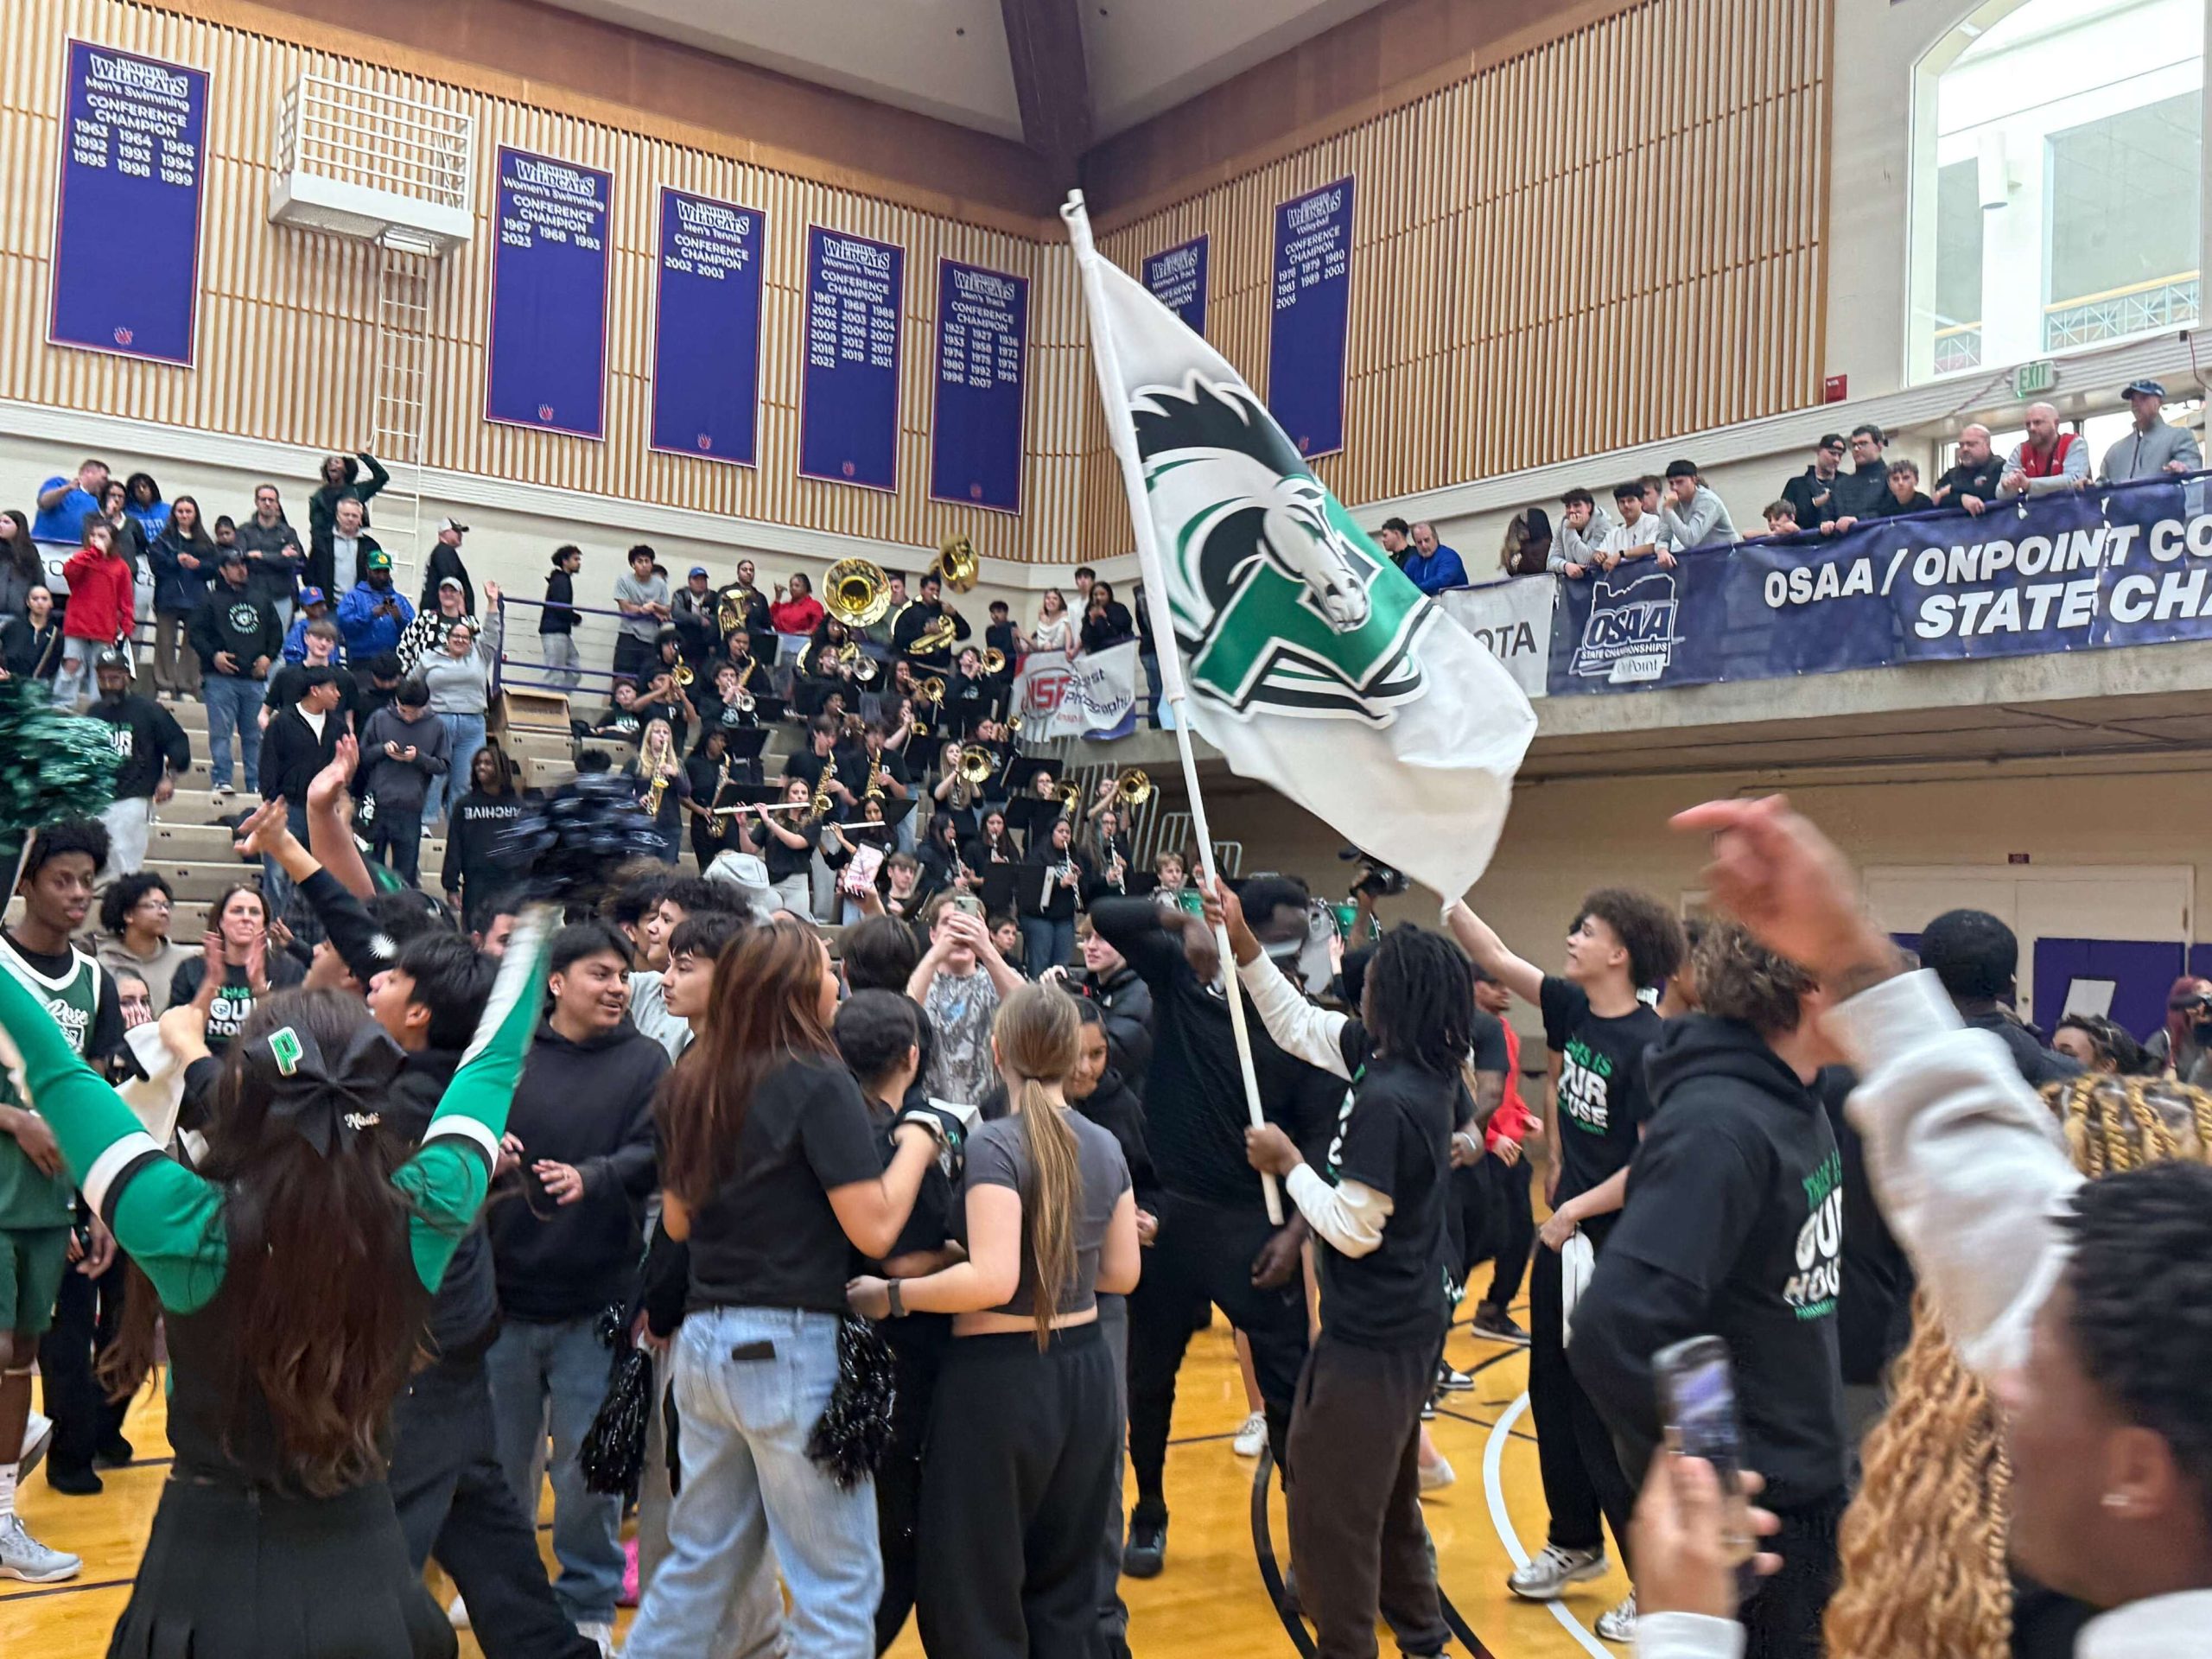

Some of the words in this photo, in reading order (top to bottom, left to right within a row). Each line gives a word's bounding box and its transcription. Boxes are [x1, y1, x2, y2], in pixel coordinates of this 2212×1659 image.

[90, 53, 188, 98] WILDCATS
[85, 75, 122, 94] Men's
[124, 86, 190, 112] Swimming
[86, 92, 188, 128] CONFERENCE
[94, 109, 177, 138] CHAMPION
[74, 118, 109, 137] 1963
[118, 128, 153, 148] 1964
[162, 138, 194, 157] 1965
[74, 133, 107, 153] 1992
[118, 143, 151, 162] 1993
[161, 153, 194, 172] 1994
[73, 148, 107, 168] 1995
[116, 158, 150, 177] 1998
[159, 168, 193, 187] 1999
[502, 175, 550, 197] Women's
[552, 188, 605, 213] Swimming
[512, 194, 594, 224] CONFERENCE
[519, 207, 586, 234] CHAMPION
[677, 198, 750, 236] WILDCATS
[501, 231, 531, 248] 2023
[503, 217, 531, 234] 1967
[539, 226, 567, 243] 1968
[574, 233, 601, 251] 1993
[674, 233, 749, 261] CONFERENCE
[683, 221, 710, 237] Men's
[712, 227, 741, 244] Tennis
[1285, 225, 1340, 256] CONFERENCE
[681, 247, 742, 271] CHAMPION
[1289, 239, 1334, 265] CHAMPION
[664, 255, 692, 273] 2002
[696, 263, 725, 280] 2003
[821, 269, 889, 296] CONFERENCE
[827, 282, 883, 304] CHAMPION
[812, 303, 837, 319] 2002
[842, 310, 867, 326] 2003
[871, 317, 895, 332] 2004
[951, 300, 1014, 325] CONFERENCE
[957, 313, 1007, 334] CHAMPION
[811, 315, 836, 331] 2005
[841, 322, 867, 338] 2006
[870, 329, 894, 344] 2007
[811, 328, 836, 344] 2008
[842, 334, 864, 350] 2012
[871, 341, 893, 356] 2017
[810, 353, 835, 369] 2022
[2019, 364, 2047, 390] EXIT
[1764, 557, 1873, 608] OSAA
[1912, 524, 2140, 586] ONPOINT
[1914, 576, 2099, 639] STATE
[1582, 601, 1677, 649] OSAA
[463, 805, 522, 820] ARCHIVE
[268, 1026, 303, 1077] P
[1783, 1255, 1841, 1307] HOU
